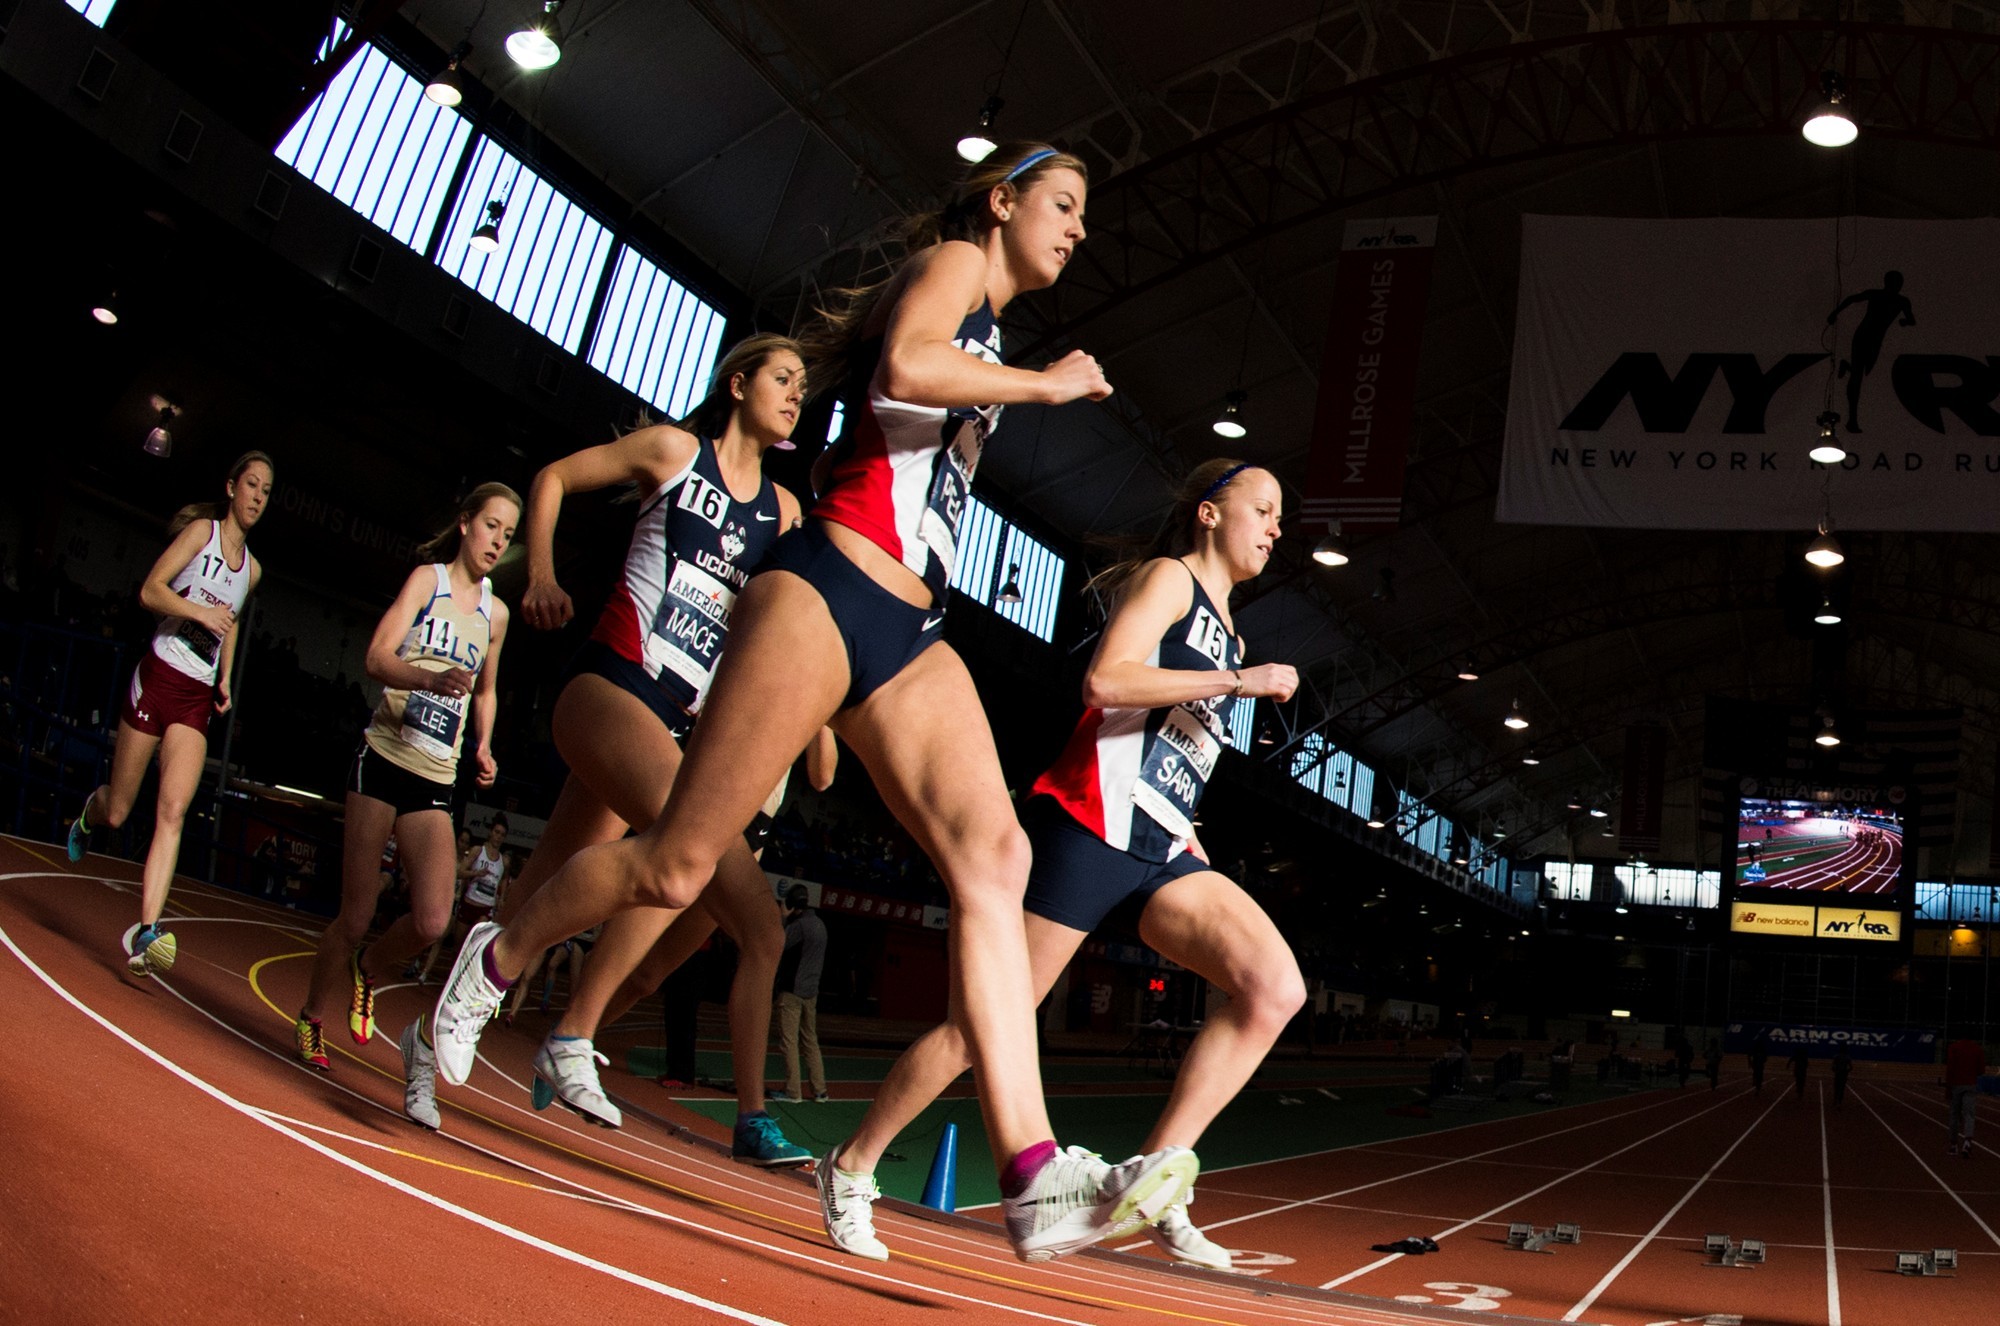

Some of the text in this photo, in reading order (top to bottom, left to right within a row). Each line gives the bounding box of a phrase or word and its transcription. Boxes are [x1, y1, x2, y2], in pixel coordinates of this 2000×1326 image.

[1342, 258, 1396, 484] MILLROSE GAMES
[1552, 447, 1637, 469] NEW
[1669, 452, 1778, 471] YORK
[689, 477, 723, 522] 16
[203, 554, 224, 580] 17
[695, 548, 750, 589] UCONN
[671, 578, 732, 631] AMERICA
[425, 618, 450, 649] 14
[665, 606, 720, 659] MACE
[1199, 614, 1224, 660] 15
[420, 705, 450, 735] LEE
[1156, 755, 1197, 809] SARA
[1765, 785, 1794, 798] THE
[1775, 917, 1810, 926] balance
[1767, 1027, 1889, 1043] ARMORY
[1845, 1040, 1889, 1048] FIELD
[1394, 1281, 1513, 1311] 3
